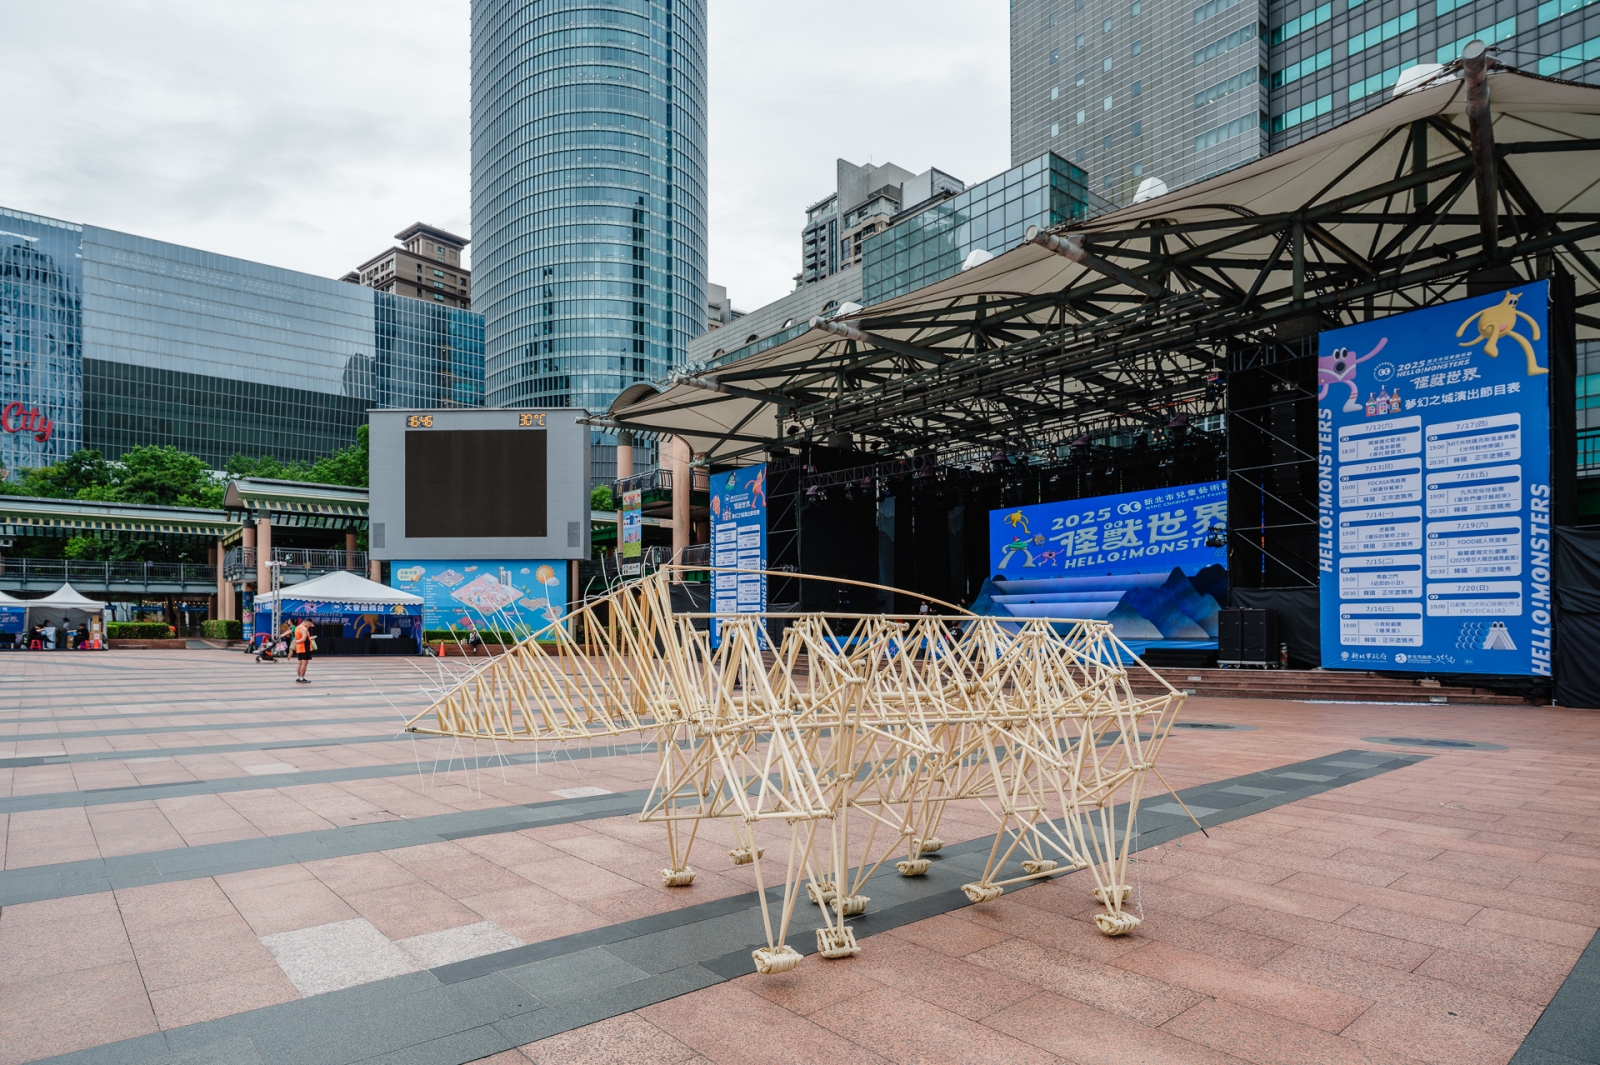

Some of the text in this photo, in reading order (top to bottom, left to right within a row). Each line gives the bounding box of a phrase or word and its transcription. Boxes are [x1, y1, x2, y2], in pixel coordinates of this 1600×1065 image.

[1396, 358, 1470, 378] HELLO!MONSTERS
[1398, 360, 1425, 372] 2025
[1410, 367, 1481, 390] 怪獸世界
[1404, 382, 1521, 411] 夢幻之城演出節目表
[2, 402, 53, 442] City
[1365, 422, 1393, 432] 7/12(六)
[1456, 421, 1488, 430] 7/17(四)
[1366, 464, 1394, 472] 7/13(日)
[1456, 472, 1488, 480] 7/18(五)
[1207, 490, 1227, 500] Festiv
[1318, 408, 1334, 572] HELLO!MONSTERS
[1049, 500, 1227, 556] 怪獸世界
[1051, 508, 1111, 530] 2025
[1065, 536, 1209, 570] HELLO!MONST
[1530, 484, 1551, 676] HELLO!MONSTERS
